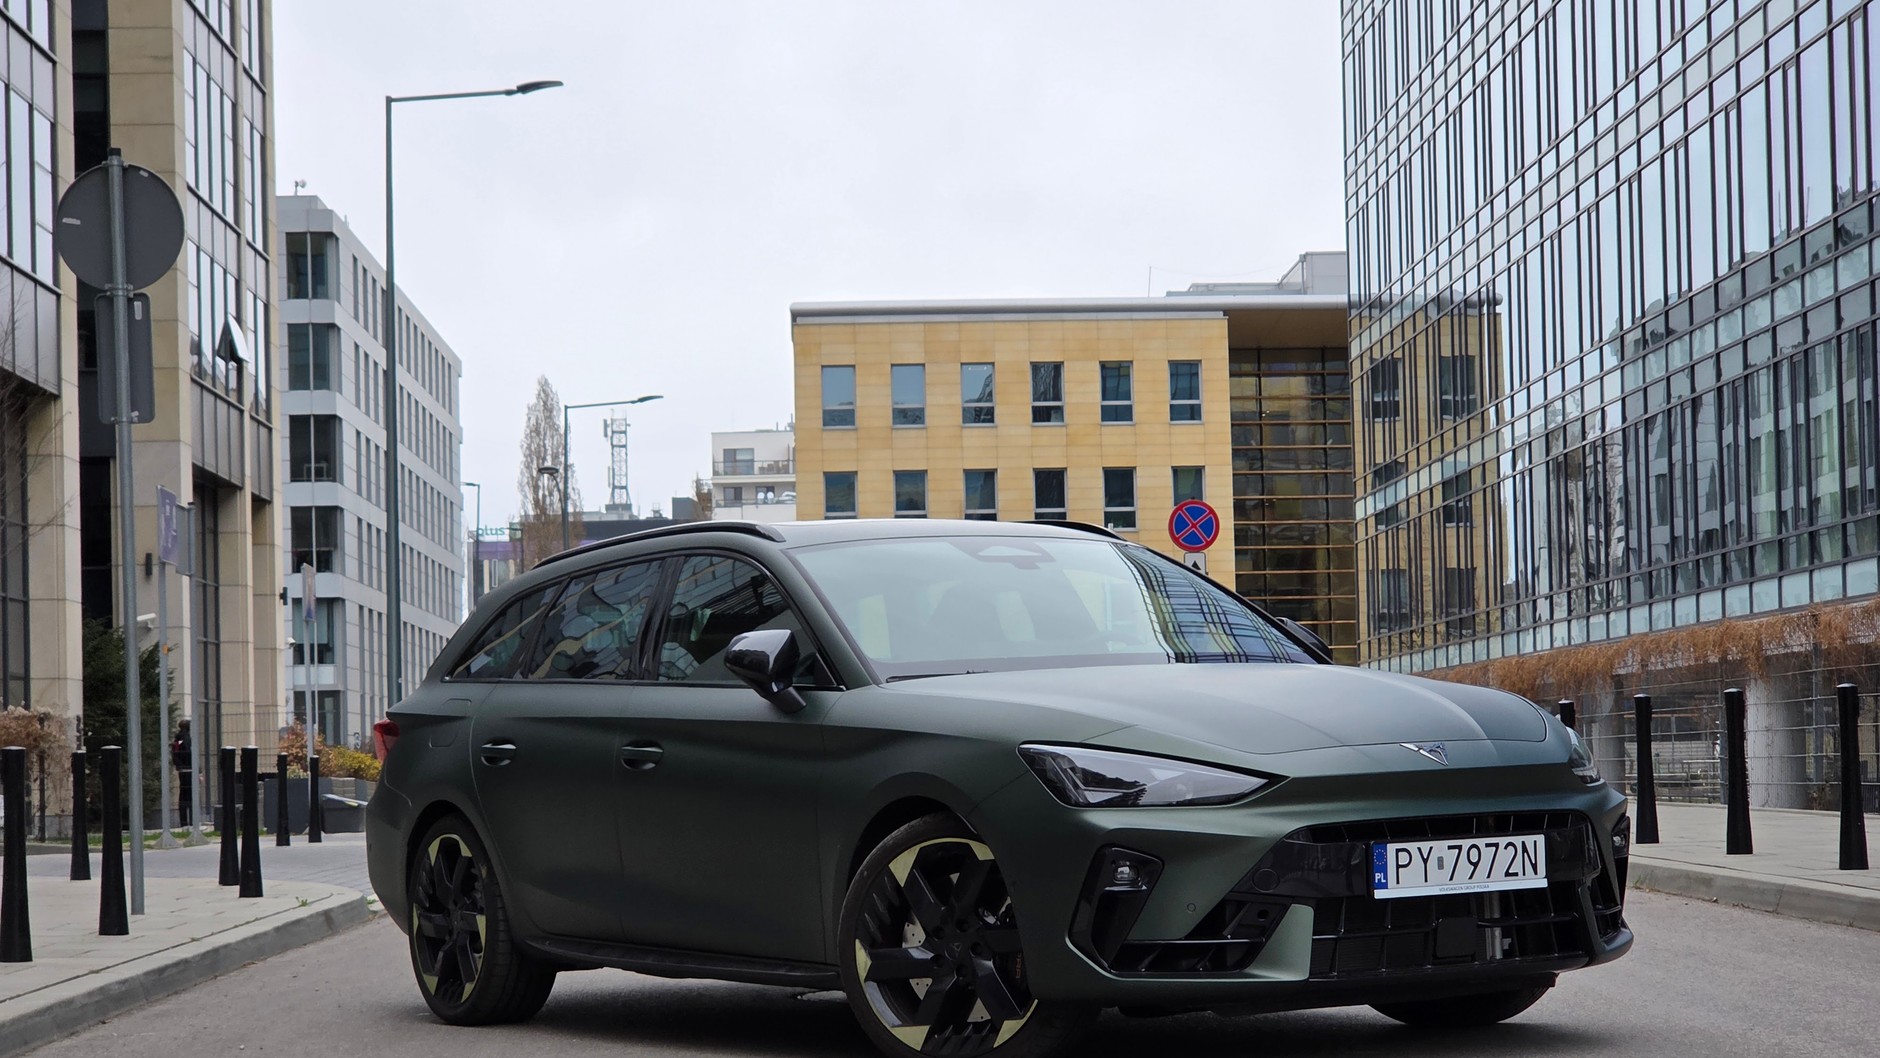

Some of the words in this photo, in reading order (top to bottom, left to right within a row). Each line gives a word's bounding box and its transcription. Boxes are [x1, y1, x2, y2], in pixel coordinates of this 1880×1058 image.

[1395, 846, 1434, 884] PY
[1447, 840, 1538, 881] 7972N
[1375, 873, 1386, 883] PL
